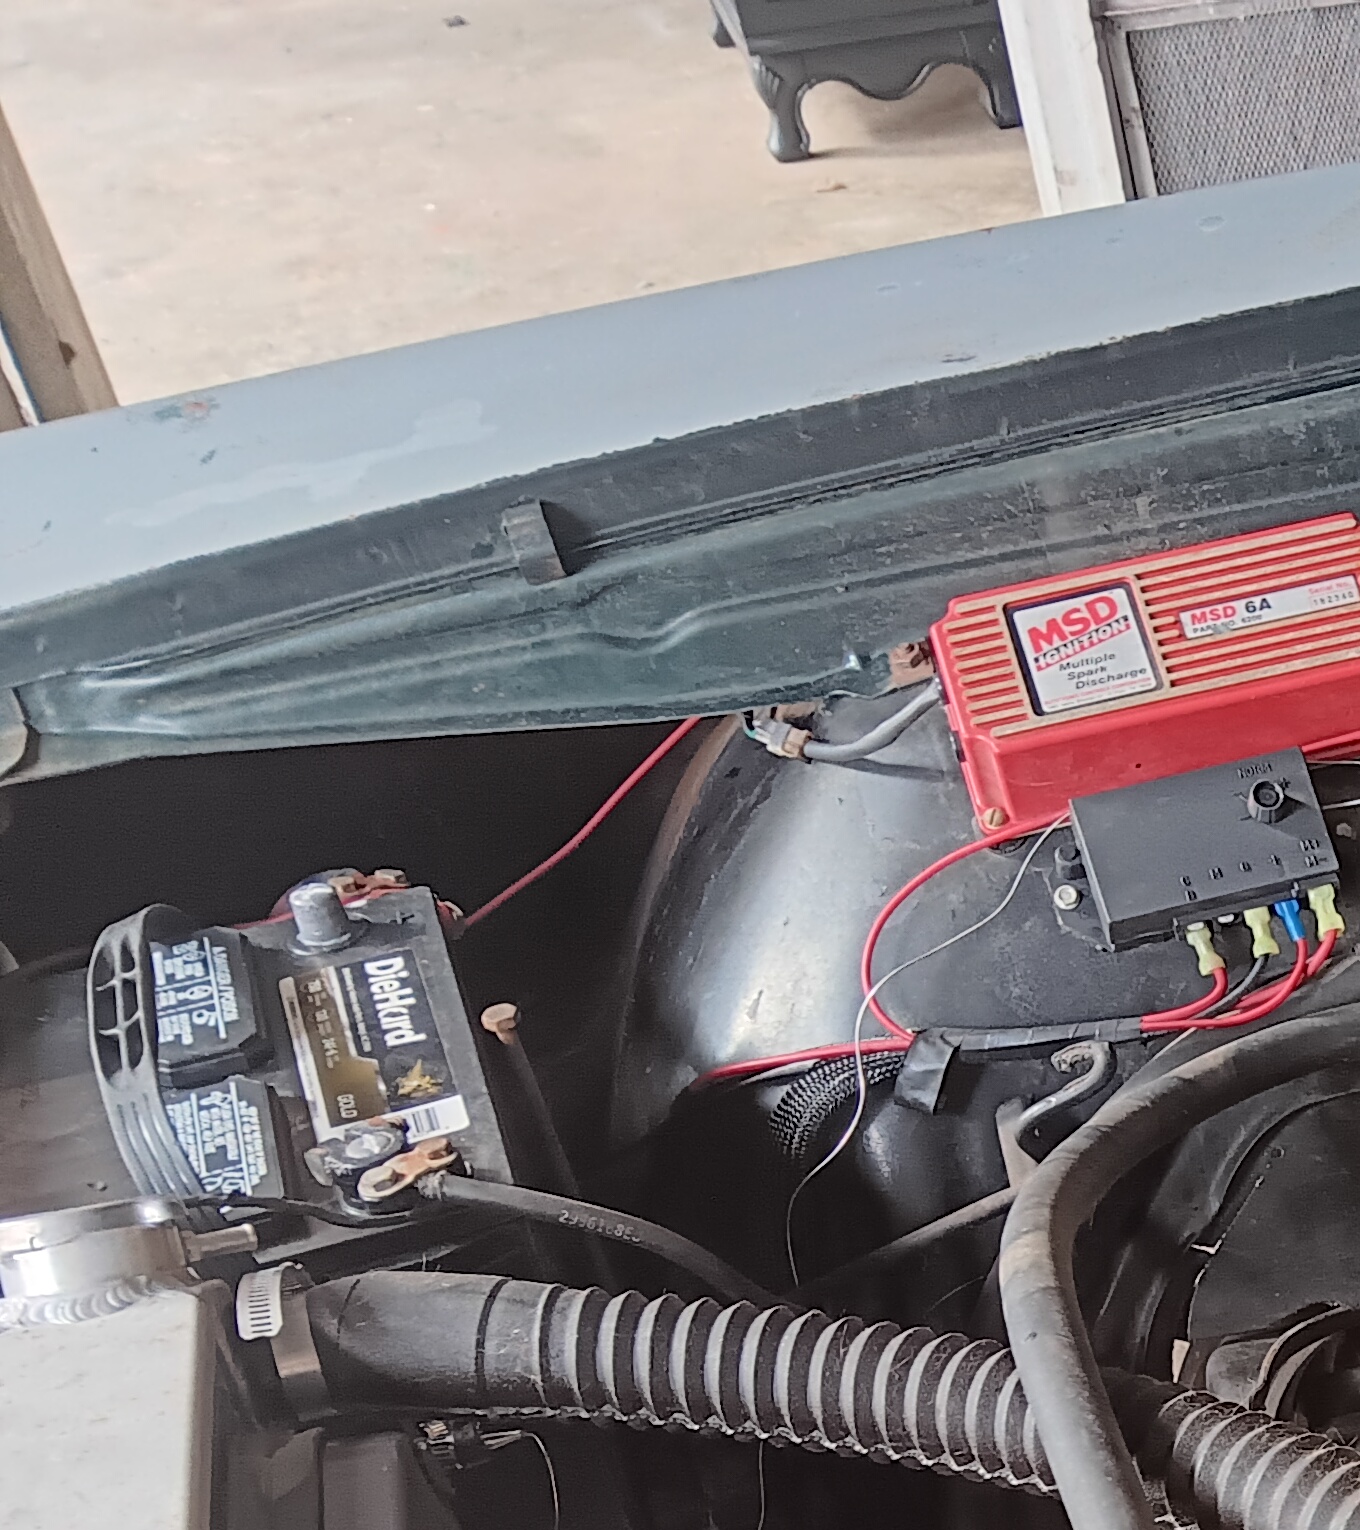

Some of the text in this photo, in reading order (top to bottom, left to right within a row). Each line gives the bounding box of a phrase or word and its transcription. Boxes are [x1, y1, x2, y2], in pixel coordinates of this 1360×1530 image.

[1027, 595, 1118, 654] MSD
[1190, 597, 1272, 626] MSD 6A
[1036, 616, 1128, 670] IGNITION
[1059, 652, 1117, 672] Multiple
[1067, 666, 1108, 681] Spark
[1075, 667, 1147, 690] Discharge
[363, 956, 427, 1047] DieHard
[336, 1093, 359, 1119] GOLD
